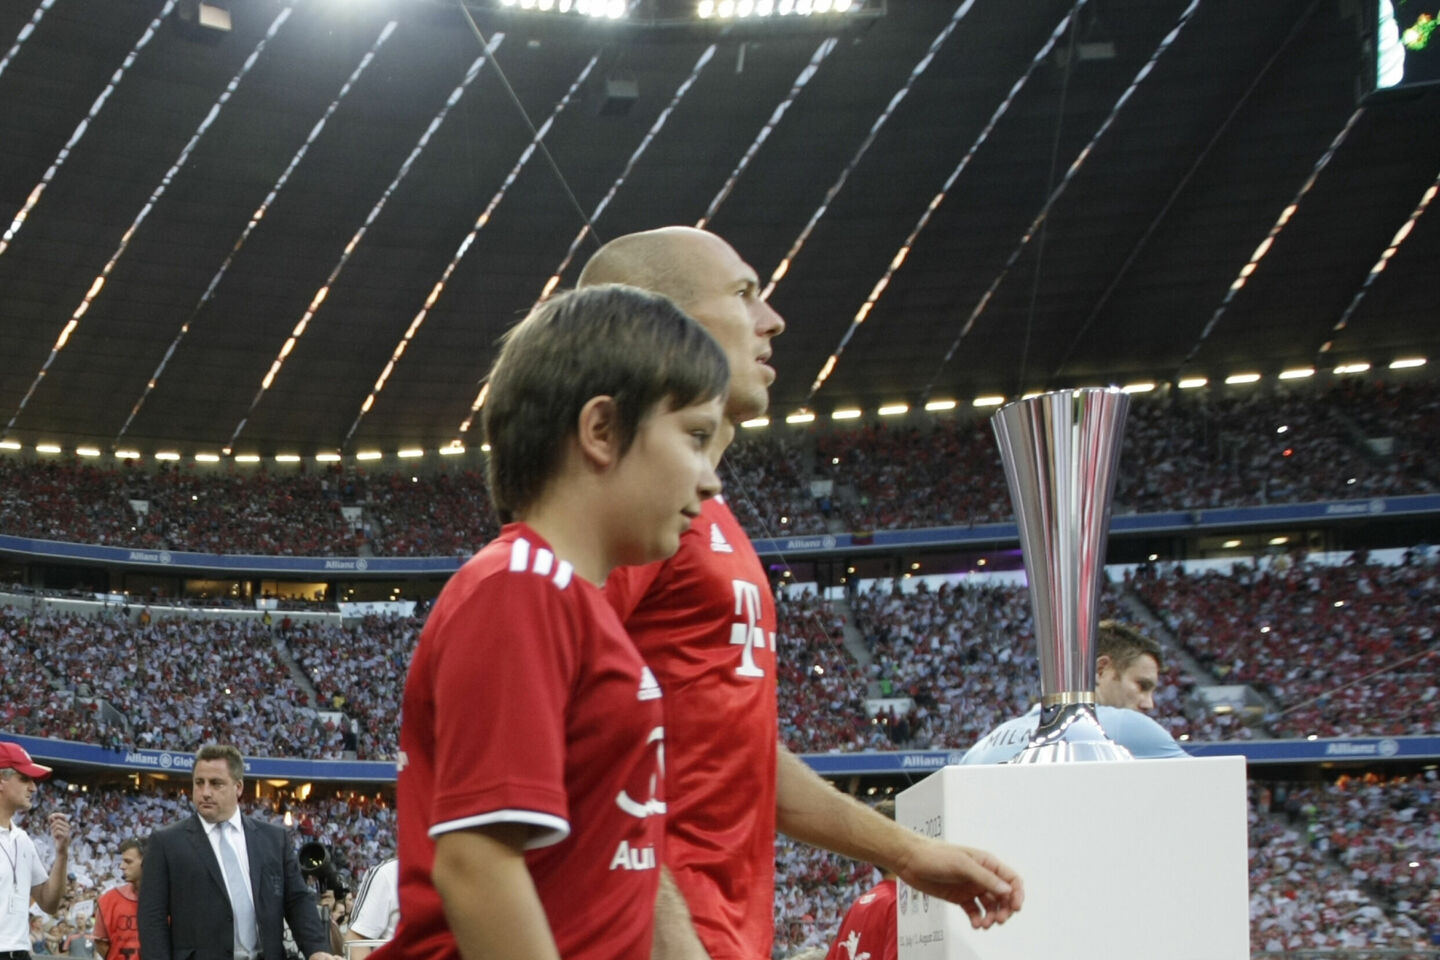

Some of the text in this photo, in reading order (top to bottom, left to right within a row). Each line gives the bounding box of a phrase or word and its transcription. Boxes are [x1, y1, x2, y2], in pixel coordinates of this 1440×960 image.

[787, 538, 821, 549] Allianz
[129, 551, 158, 562] Allianz
[325, 560, 355, 570] Allianz
[1326, 742, 1376, 755] Allianz
[125, 752, 158, 765] Allianz
[902, 755, 946, 768] Allianz
